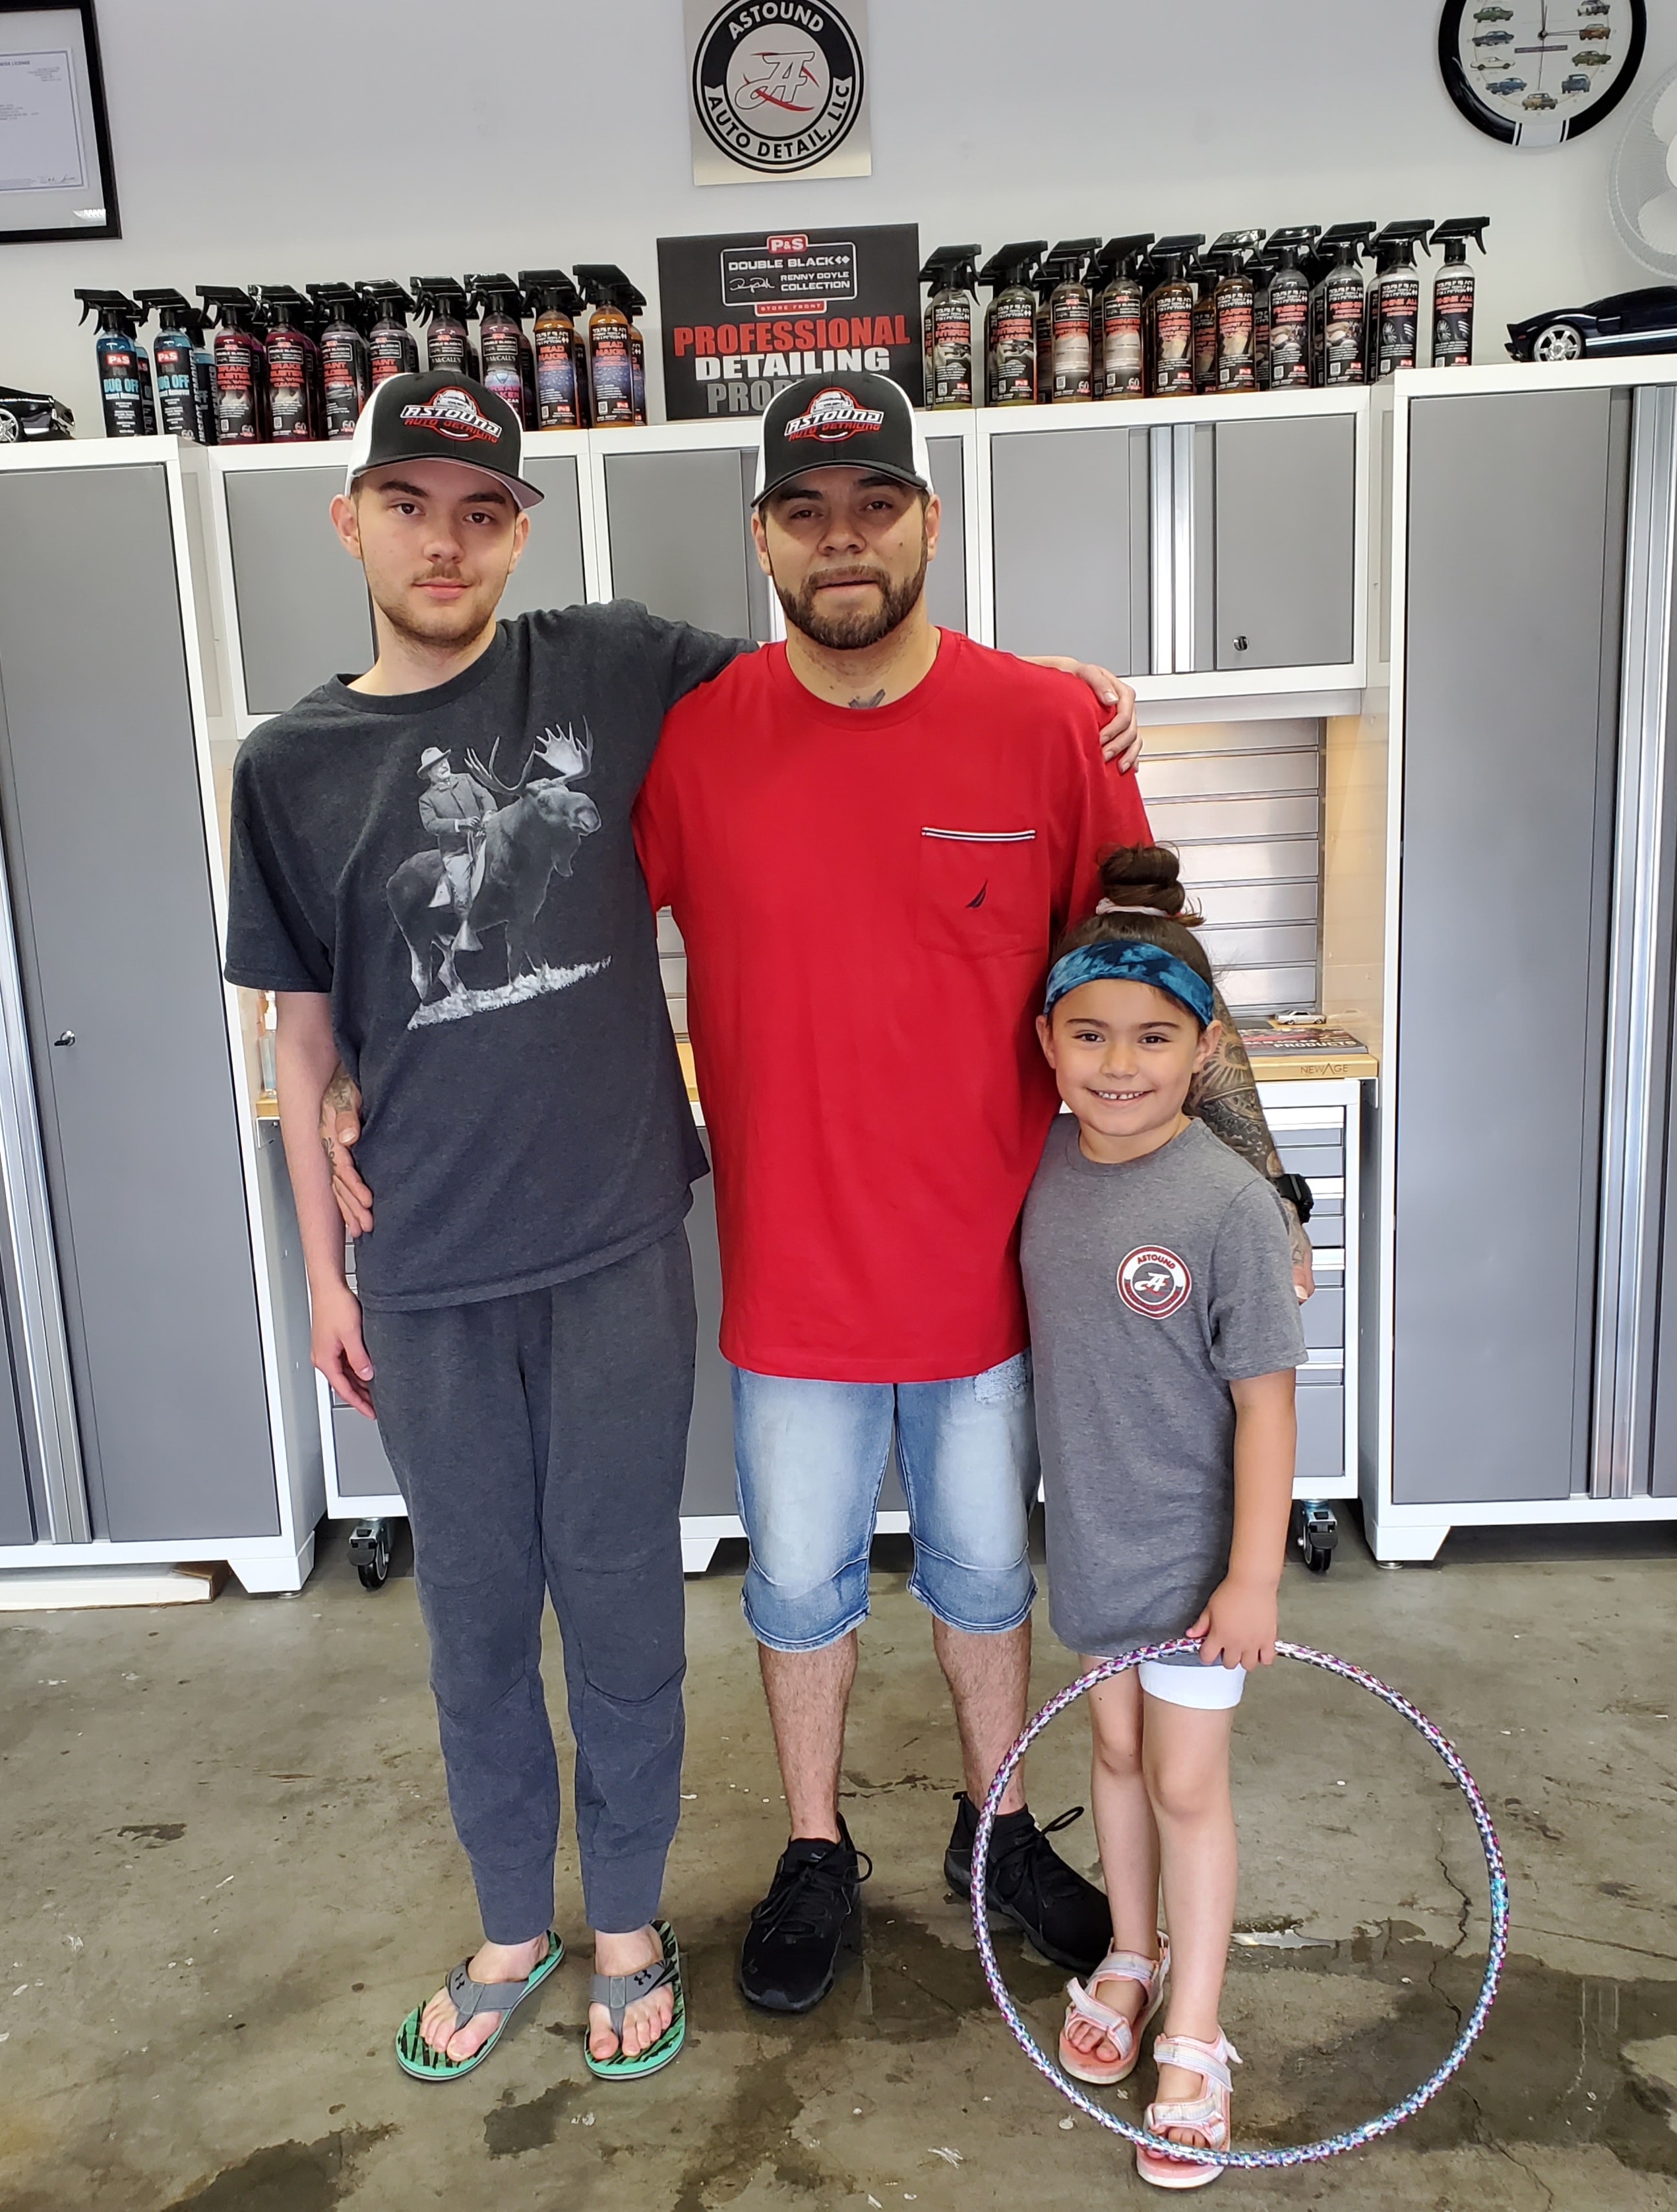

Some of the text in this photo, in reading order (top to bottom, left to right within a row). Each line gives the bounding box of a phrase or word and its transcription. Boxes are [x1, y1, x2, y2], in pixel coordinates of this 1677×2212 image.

[727, 1, 824, 40] ASTOUND
[708, 84, 849, 159] AUTO DETAIL, LLC
[771, 238, 804, 251] P&S
[728, 256, 835, 271] DOUBLE BLACK
[780, 271, 849, 282] RENNY DOYLE
[781, 281, 851, 292] COLLECTION
[673, 314, 911, 357] PROFESSIONAL
[108, 355, 131, 365] P&S
[157, 352, 178, 362] P&S
[694, 347, 890, 381] DETAILING
[103, 378, 123, 393] BUG
[171, 374, 190, 388] OFF
[1078, 381, 1089, 390] 60
[1128, 378, 1140, 387] 60
[404, 407, 499, 436] ASTOUND
[788, 411, 880, 433] ASTOUND
[442, 421, 498, 444] DETAILING
[788, 421, 881, 442] AUTO DETAILING
[1137, 1254, 1176, 1270] ASTOUND
